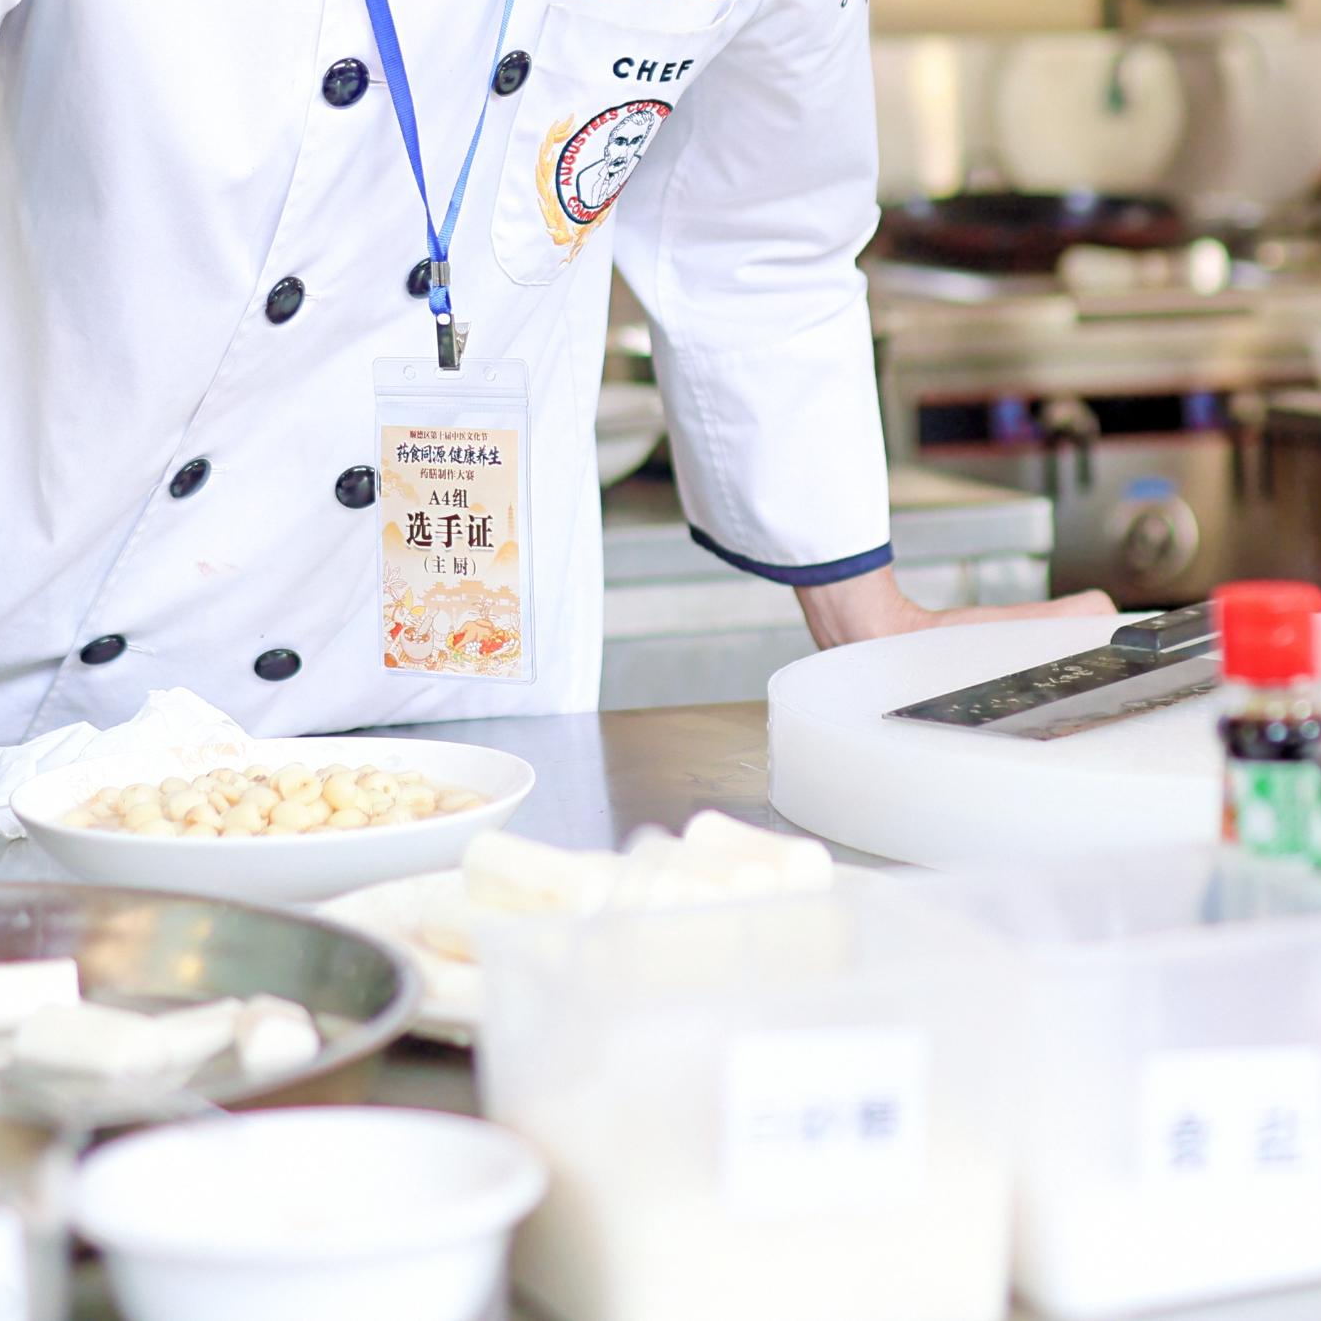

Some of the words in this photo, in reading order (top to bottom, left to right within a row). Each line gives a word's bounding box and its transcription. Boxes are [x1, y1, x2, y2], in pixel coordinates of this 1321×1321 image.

[613, 57, 694, 82] CHEF
[396, 442, 447, 464] 药食同源
[448, 444, 502, 467] 健康养生
[420, 467, 475, 481] 药膳制作大赛
[428, 489, 469, 508] A4组
[406, 511, 494, 548] 选手证
